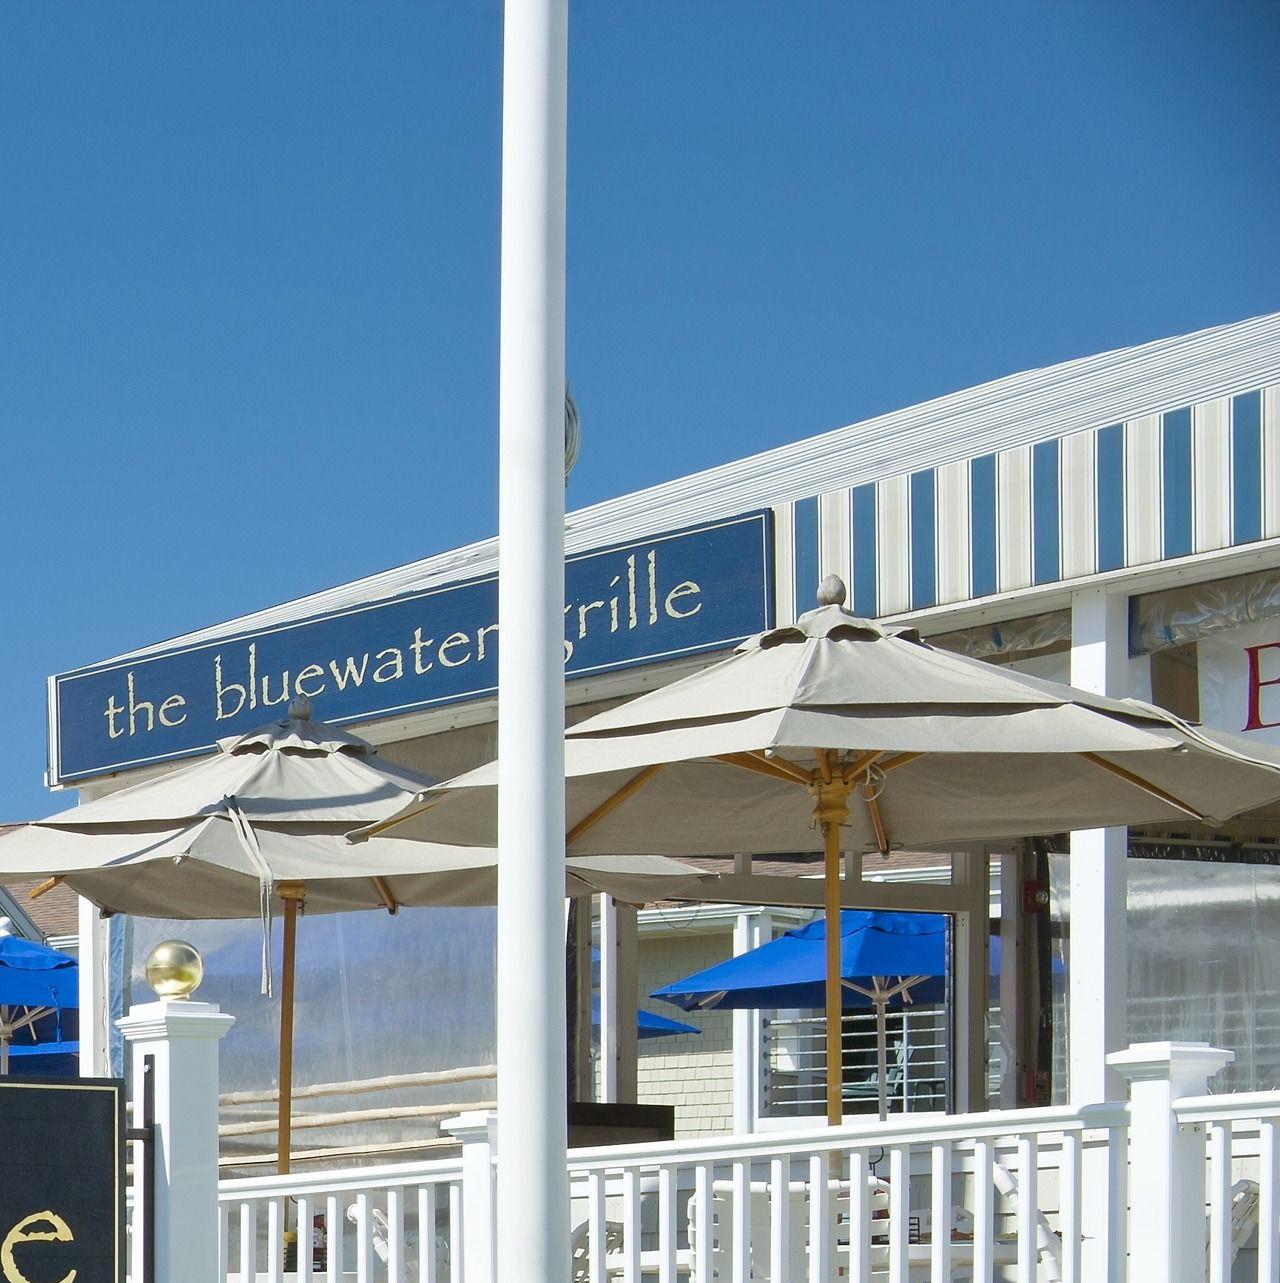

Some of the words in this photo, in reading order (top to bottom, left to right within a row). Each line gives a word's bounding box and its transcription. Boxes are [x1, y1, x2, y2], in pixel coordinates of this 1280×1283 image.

[103, 670, 188, 740] the
[215, 624, 500, 722] bluewater
[563, 548, 704, 665] rille
